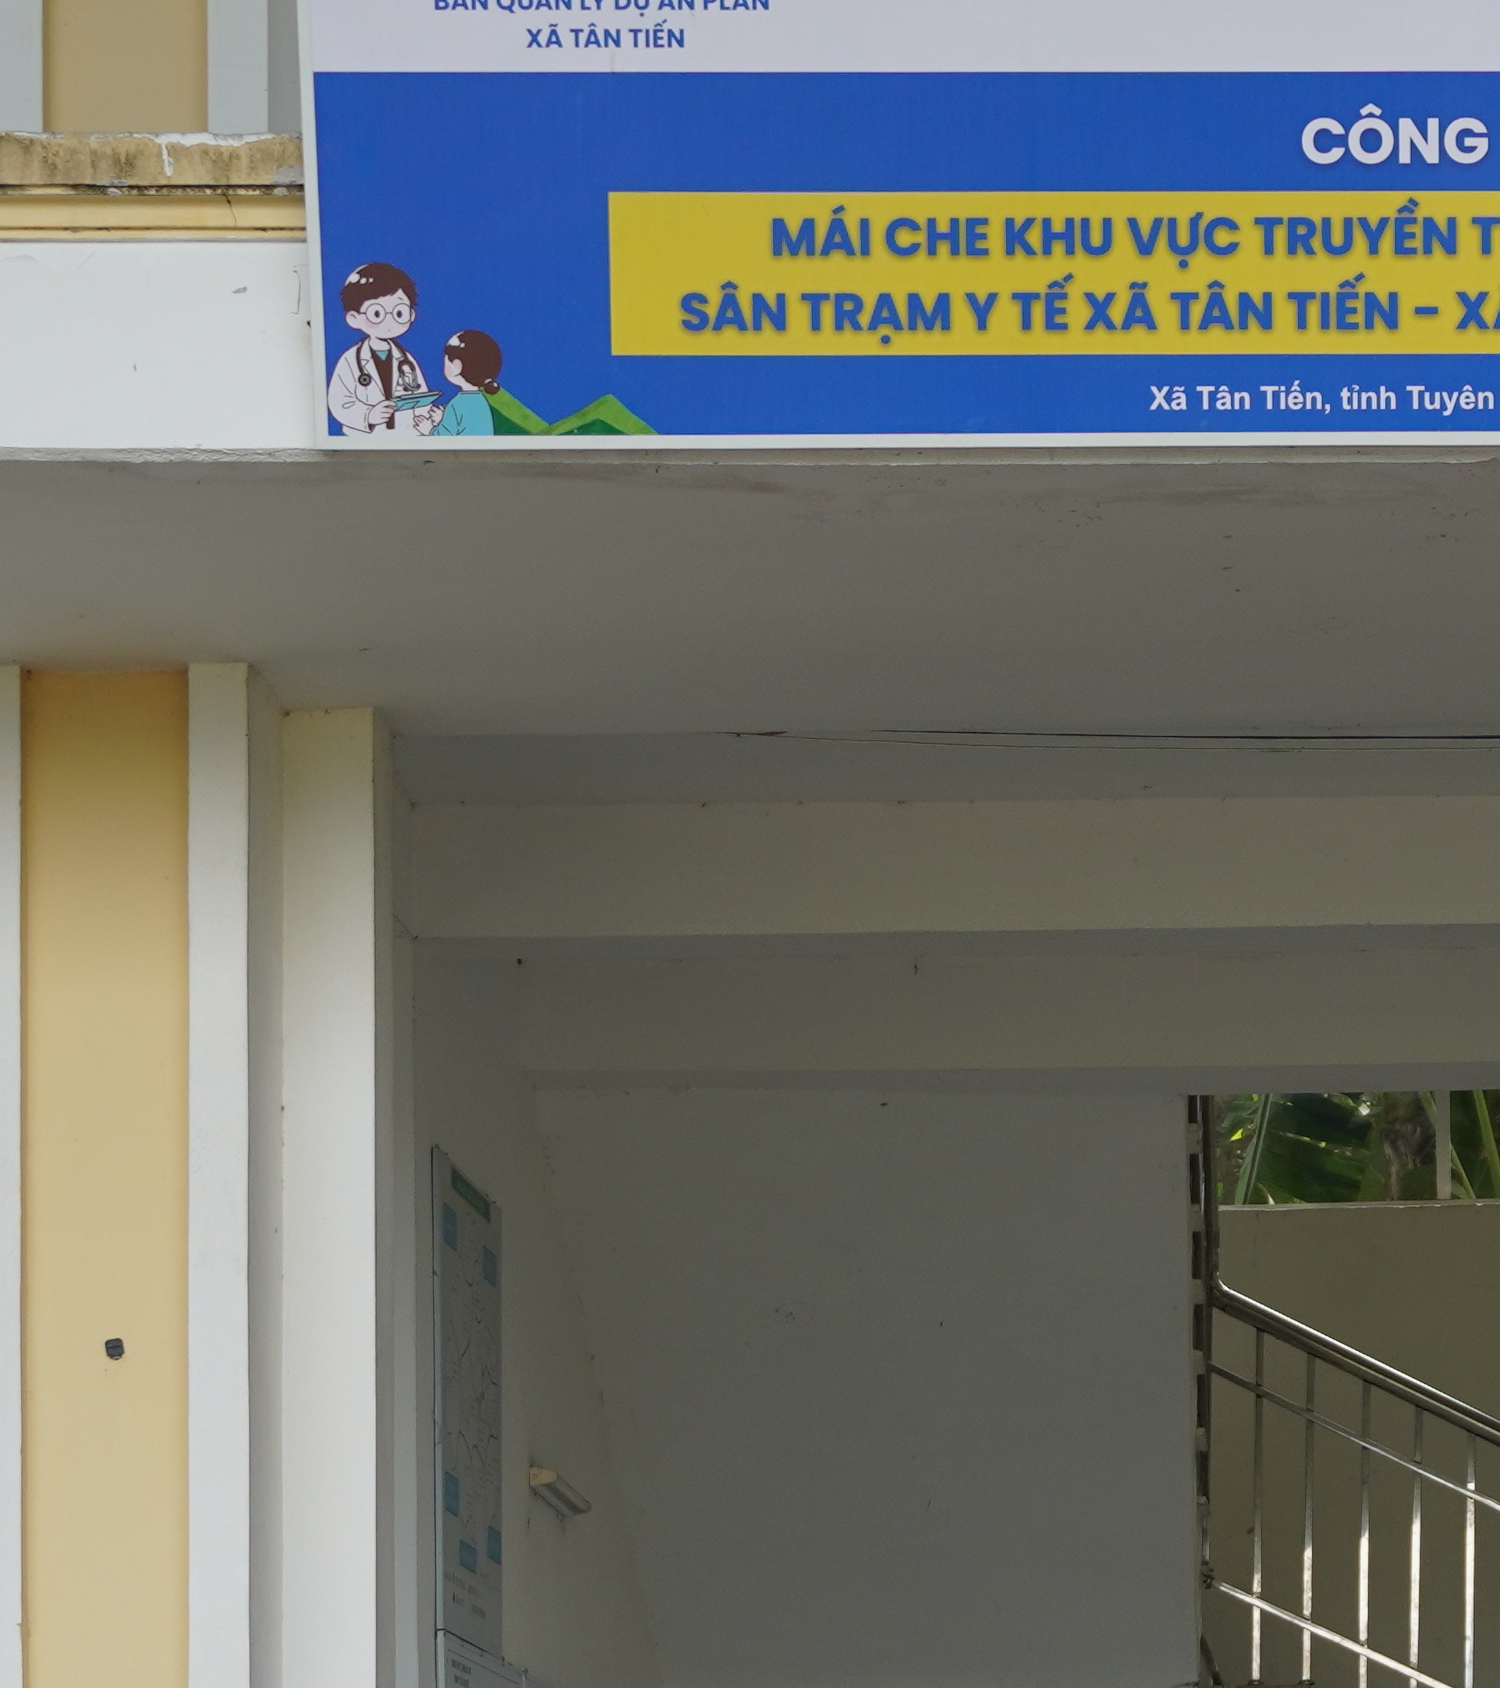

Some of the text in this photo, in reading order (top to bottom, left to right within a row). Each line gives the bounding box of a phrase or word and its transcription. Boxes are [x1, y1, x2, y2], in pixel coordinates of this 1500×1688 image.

[527, 19, 684, 48] XÃ TÂN TIẾN
[1302, 103, 1488, 164] CÔNG
[772, 205, 870, 256] MÁI
[884, 217, 989, 257] CHE
[1004, 217, 1112, 256] KHU
[1127, 212, 1240, 269] VỰC
[1259, 197, 1457, 257] TRUYỀN
[680, 281, 786, 332] SÂN
[801, 292, 951, 344] TRẠM
[965, 292, 998, 331] Y
[1011, 273, 1074, 331] TẾ
[1084, 282, 1157, 330] XÃ
[1170, 280, 1272, 330] TÂN
[1287, 273, 1398, 330] TIẾN
[1150, 386, 1187, 410] Xã
[1196, 386, 1250, 410] Tân
[1261, 380, 1330, 414] Tiến,
[1341, 385, 1396, 410] tỉnh
[1406, 385, 1494, 416] Tuyên
